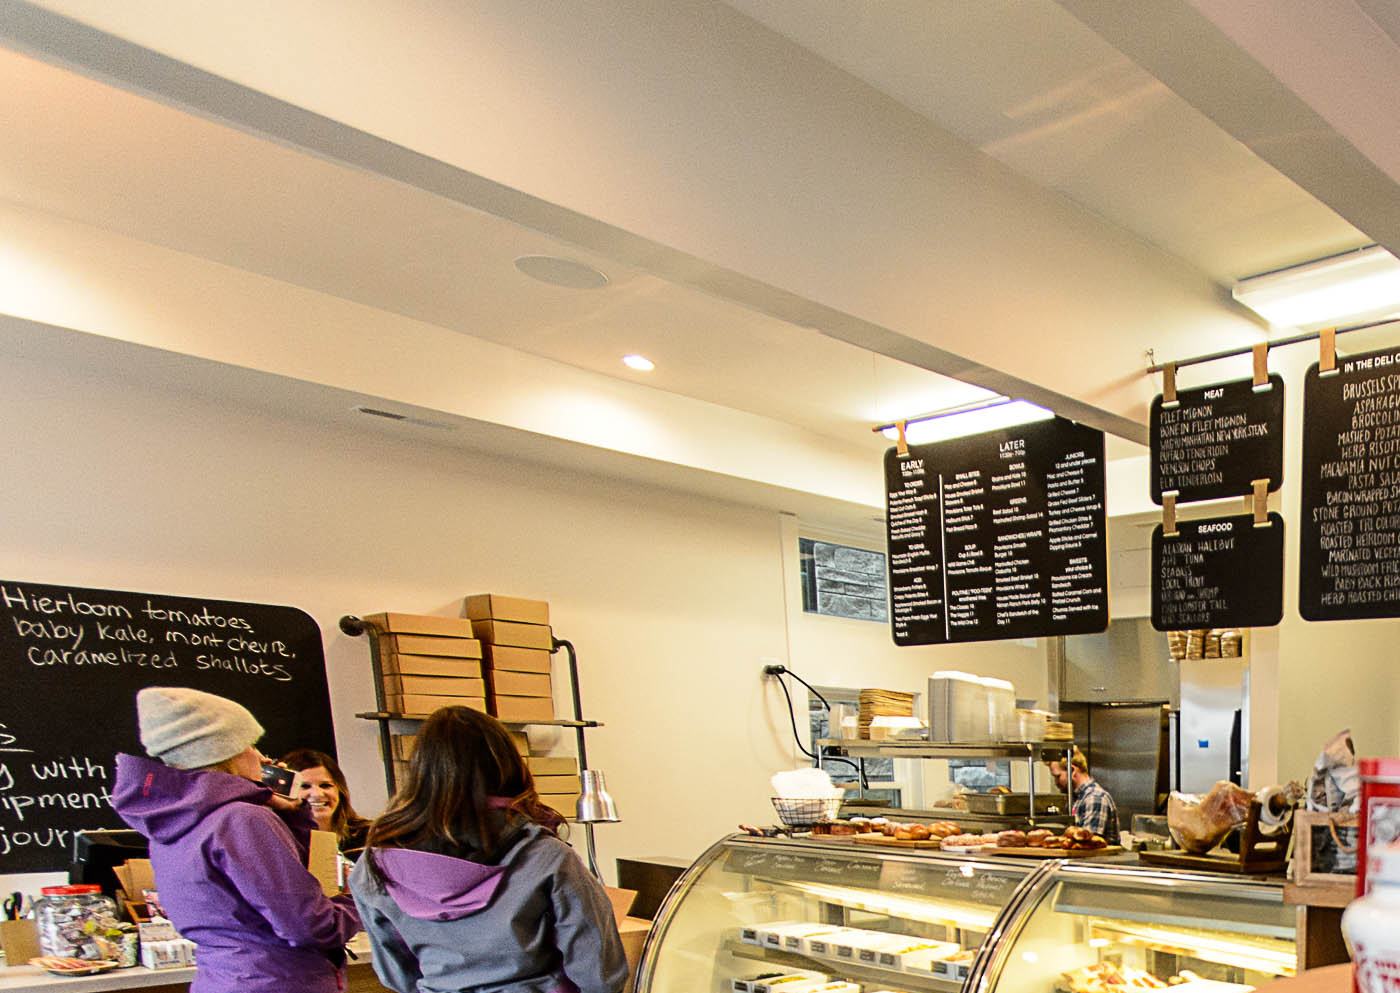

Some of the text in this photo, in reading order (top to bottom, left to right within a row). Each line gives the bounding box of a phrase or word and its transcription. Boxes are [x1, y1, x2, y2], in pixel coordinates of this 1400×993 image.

[1345, 363, 1353, 373] IN
[1356, 359, 1372, 370] THE
[1375, 355, 1393, 366] DELI
[1204, 388, 1224, 400] MEAT
[1343, 376, 1385, 401] BRUSSELS
[1160, 405, 1213, 424] FILET MIGNON
[1192, 419, 1213, 433] FILET
[1214, 413, 1247, 429] MIGNON
[1216, 429, 1231, 441] NEW
[1337, 429, 1370, 446] MASHED
[1000, 440, 1025, 452] LATER
[1342, 445, 1365, 459] HERB
[901, 459, 923, 471] EARLY
[1191, 458, 1216, 471] CHOPS
[1321, 459, 1364, 479] MACADAMIA
[1369, 456, 1391, 471] NUT
[1160, 472, 1223, 489] ELK TENDERLOIN
[1348, 475, 1374, 489] PASTA
[1327, 490, 1352, 505] BACON
[1354, 486, 1389, 502] WRAPPED
[1313, 506, 1339, 522] STONE
[1343, 503, 1379, 518] GROUND
[1198, 523, 1233, 533] SEAFOOD
[1320, 520, 1353, 536] ROASTED
[1198, 538, 1235, 552] HALIBUT
[1320, 535, 1352, 550] ROASTED
[1356, 532, 1395, 547] HEIRLOOM
[1185, 553, 1204, 564] TUNA
[1329, 549, 1371, 563] MARINATED
[1321, 564, 1339, 577] WILD
[1341, 562, 1379, 576] MUSHROOM
[1335, 577, 1355, 591] BABY
[1358, 576, 1381, 589] BACK
[1321, 592, 1345, 606] HERB
[1348, 590, 1381, 603] ROASTED
[13, 617, 84, 649] baby
[32, 756, 106, 780] with
[0, 785, 113, 821] ipment
